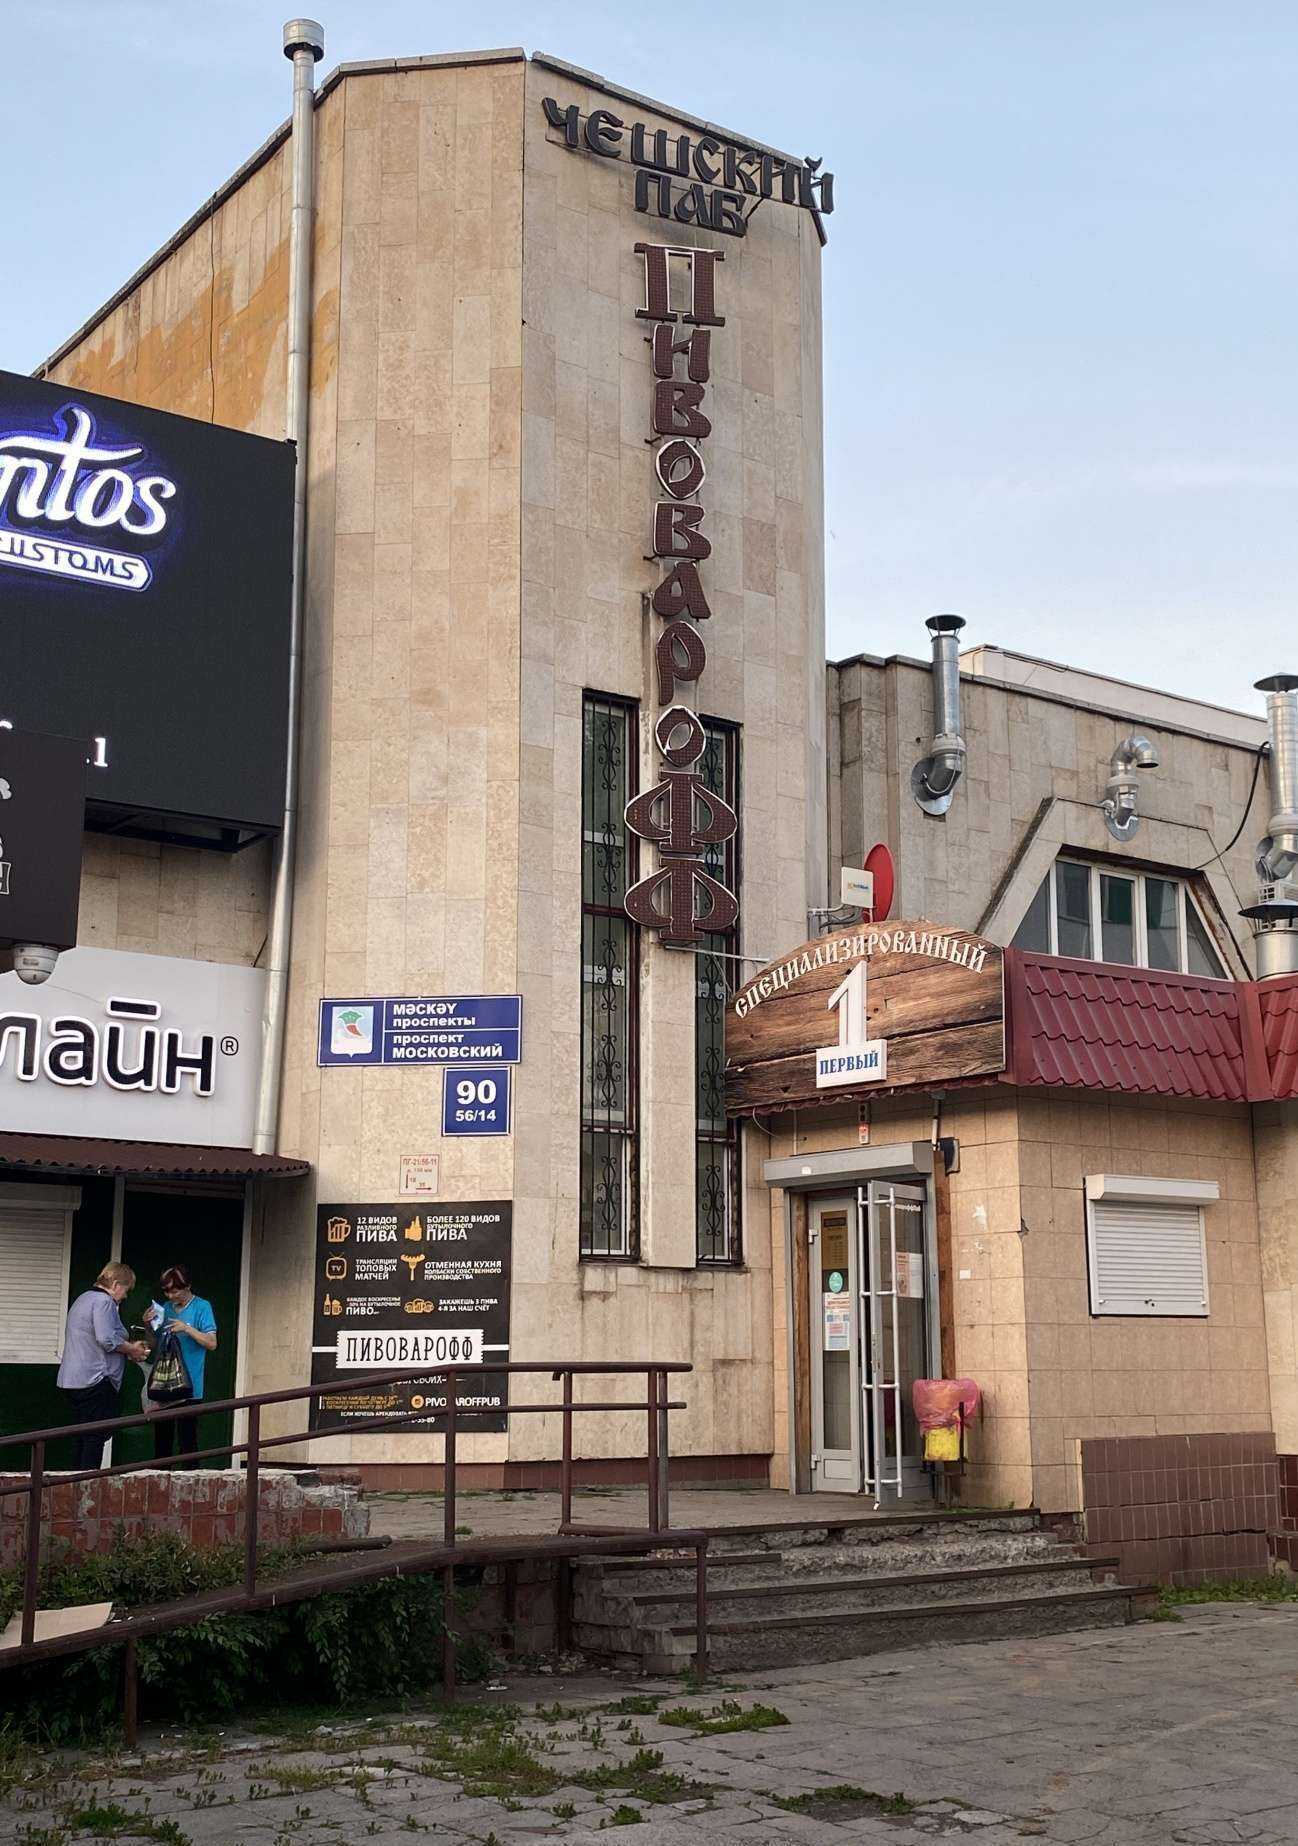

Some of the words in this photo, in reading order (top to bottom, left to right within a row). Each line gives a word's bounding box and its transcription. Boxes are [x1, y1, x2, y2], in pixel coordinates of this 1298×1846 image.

[541, 97, 835, 214] ЧЕШСКИЙ
[633, 168, 748, 238] ПАБ
[623, 242, 739, 941] ПИВОВАРОФФ
[735, 930, 988, 1019] СПЕЦИАЛИЗИРОВАННЫЙ
[827, 960, 868, 1048] 1
[393, 1016, 475, 1028] проспекты
[393, 1034, 464, 1045] проспект
[392, 1043, 502, 1059] МОСКОВСКИЙ
[819, 1050, 879, 1075] ПЕРВЫЙ
[456, 1079, 497, 1105] 90
[455, 1109, 497, 1123] 56/14
[368, 1216, 398, 1225] ВИДОВ
[470, 1215, 500, 1223] ВИДОВ
[356, 1230, 398, 1242] ПИВА
[426, 1229, 468, 1241] ПИВА
[424, 1261, 472, 1269] ОТМЕННАЯ
[355, 1272, 389, 1280] МАТЧЕЙ
[346, 1306, 374, 1316] ПИВО
[346, 1336, 473, 1362] ПИВОВАРОФФ
